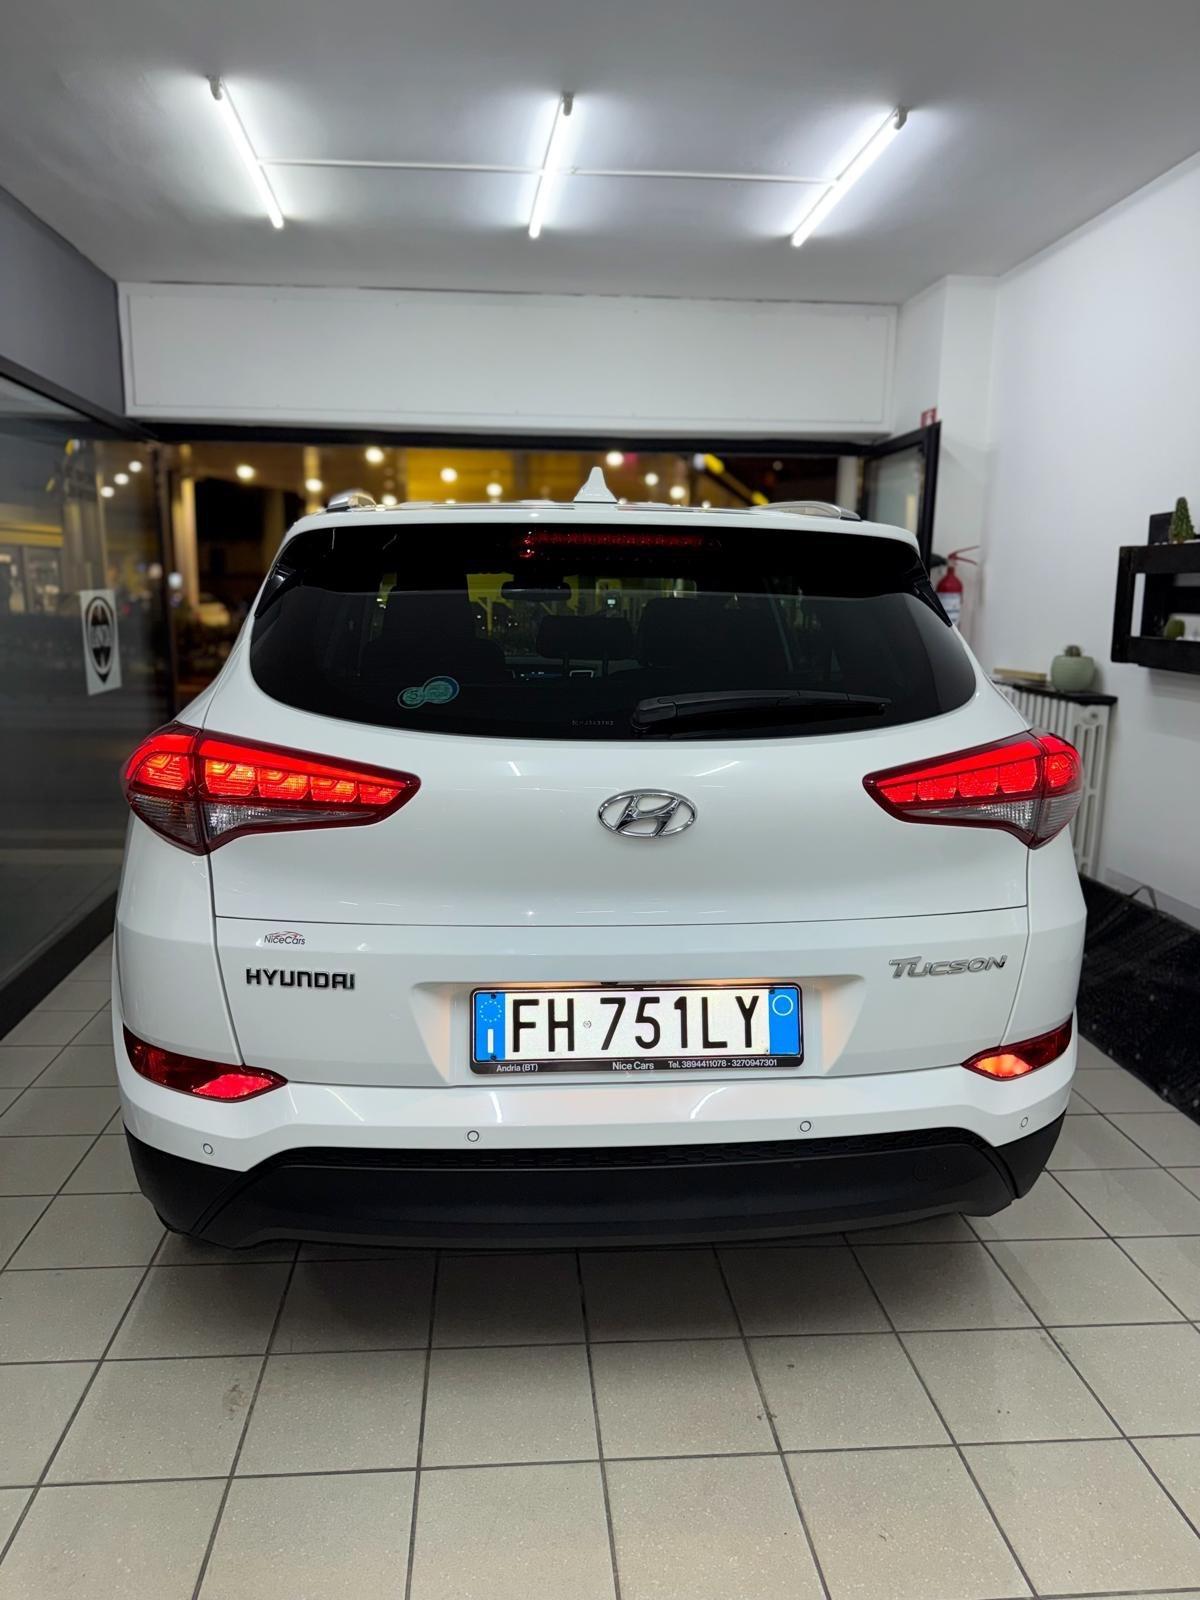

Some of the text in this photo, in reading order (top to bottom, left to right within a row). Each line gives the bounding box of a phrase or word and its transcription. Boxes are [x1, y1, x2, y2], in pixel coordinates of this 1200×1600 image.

[264, 935, 306, 945] NiceCars
[888, 954, 1008, 979] TUCSON
[246, 968, 355, 990] HYUNDAI
[512, 995, 760, 1053] FH 751LY
[496, 1063, 538, 1073] Andria (BT)
[612, 1061, 654, 1070] Nice Cars
[668, 1060, 680, 1068] Tel.
